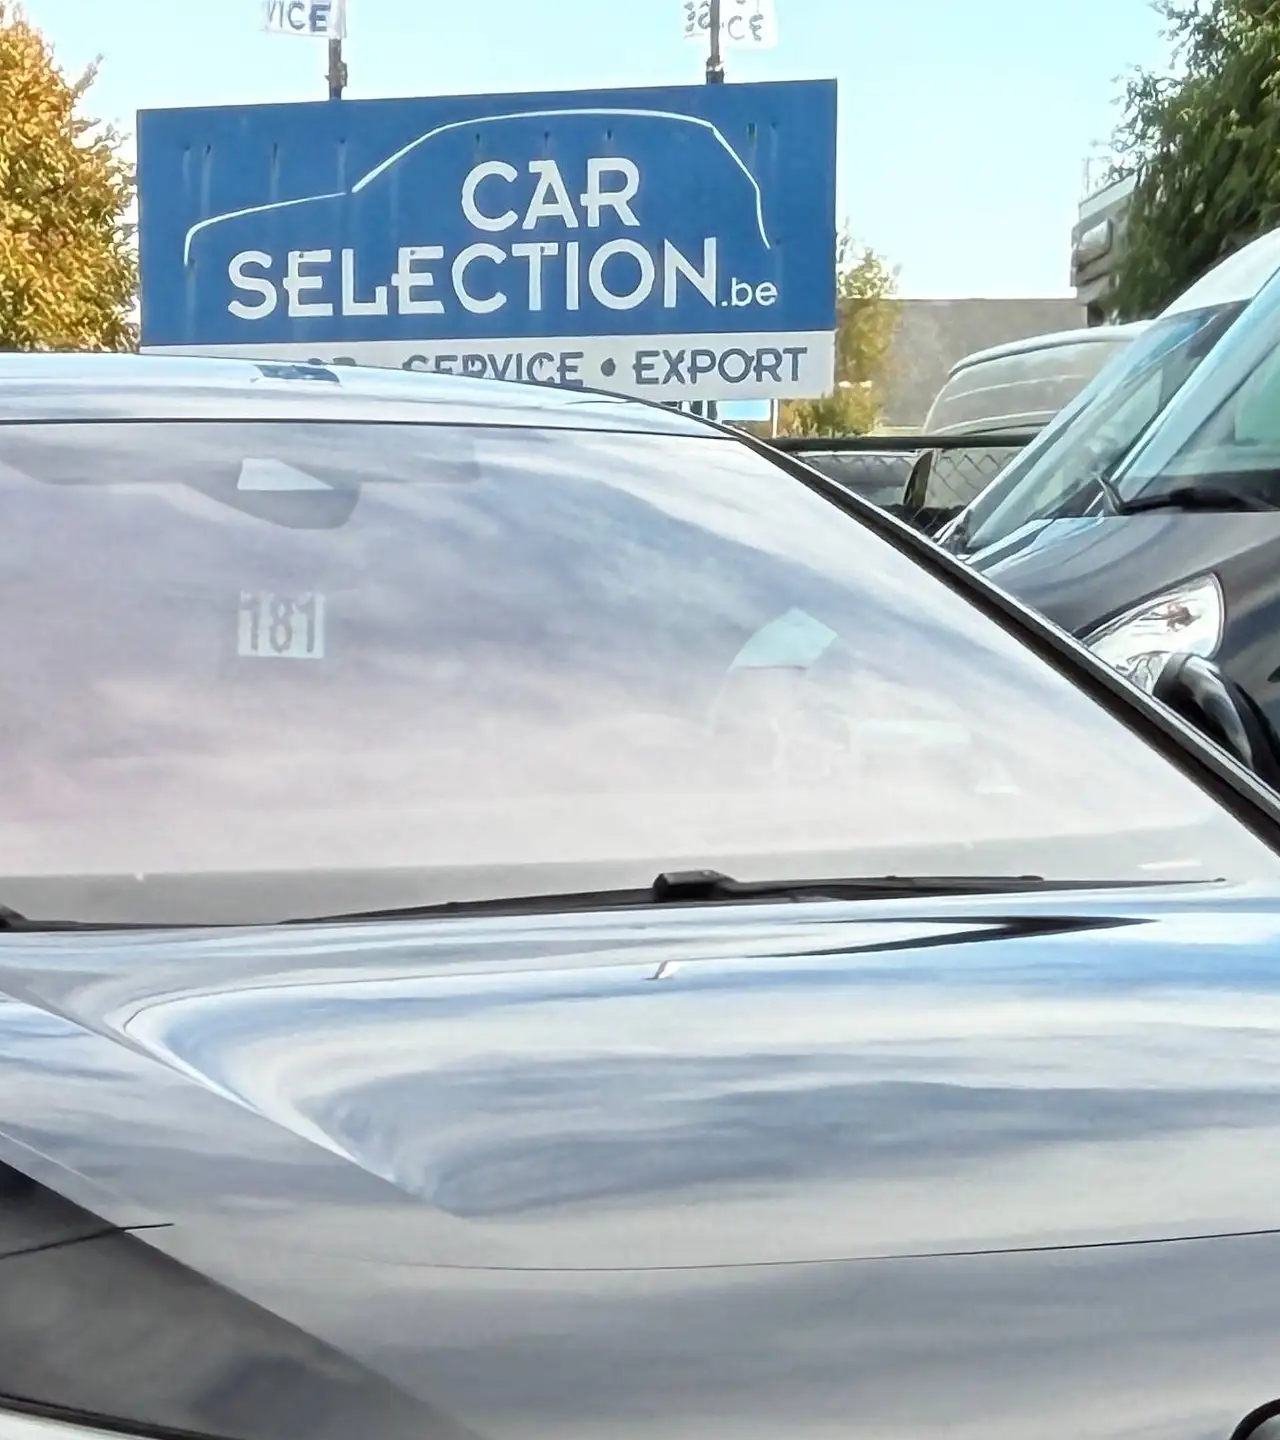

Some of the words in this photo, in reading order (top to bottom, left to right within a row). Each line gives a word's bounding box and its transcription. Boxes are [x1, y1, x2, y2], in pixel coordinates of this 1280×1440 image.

[461, 157, 641, 232] CAR
[632, 346, 808, 386] EXPORT
[237, 596, 317, 655] 181
